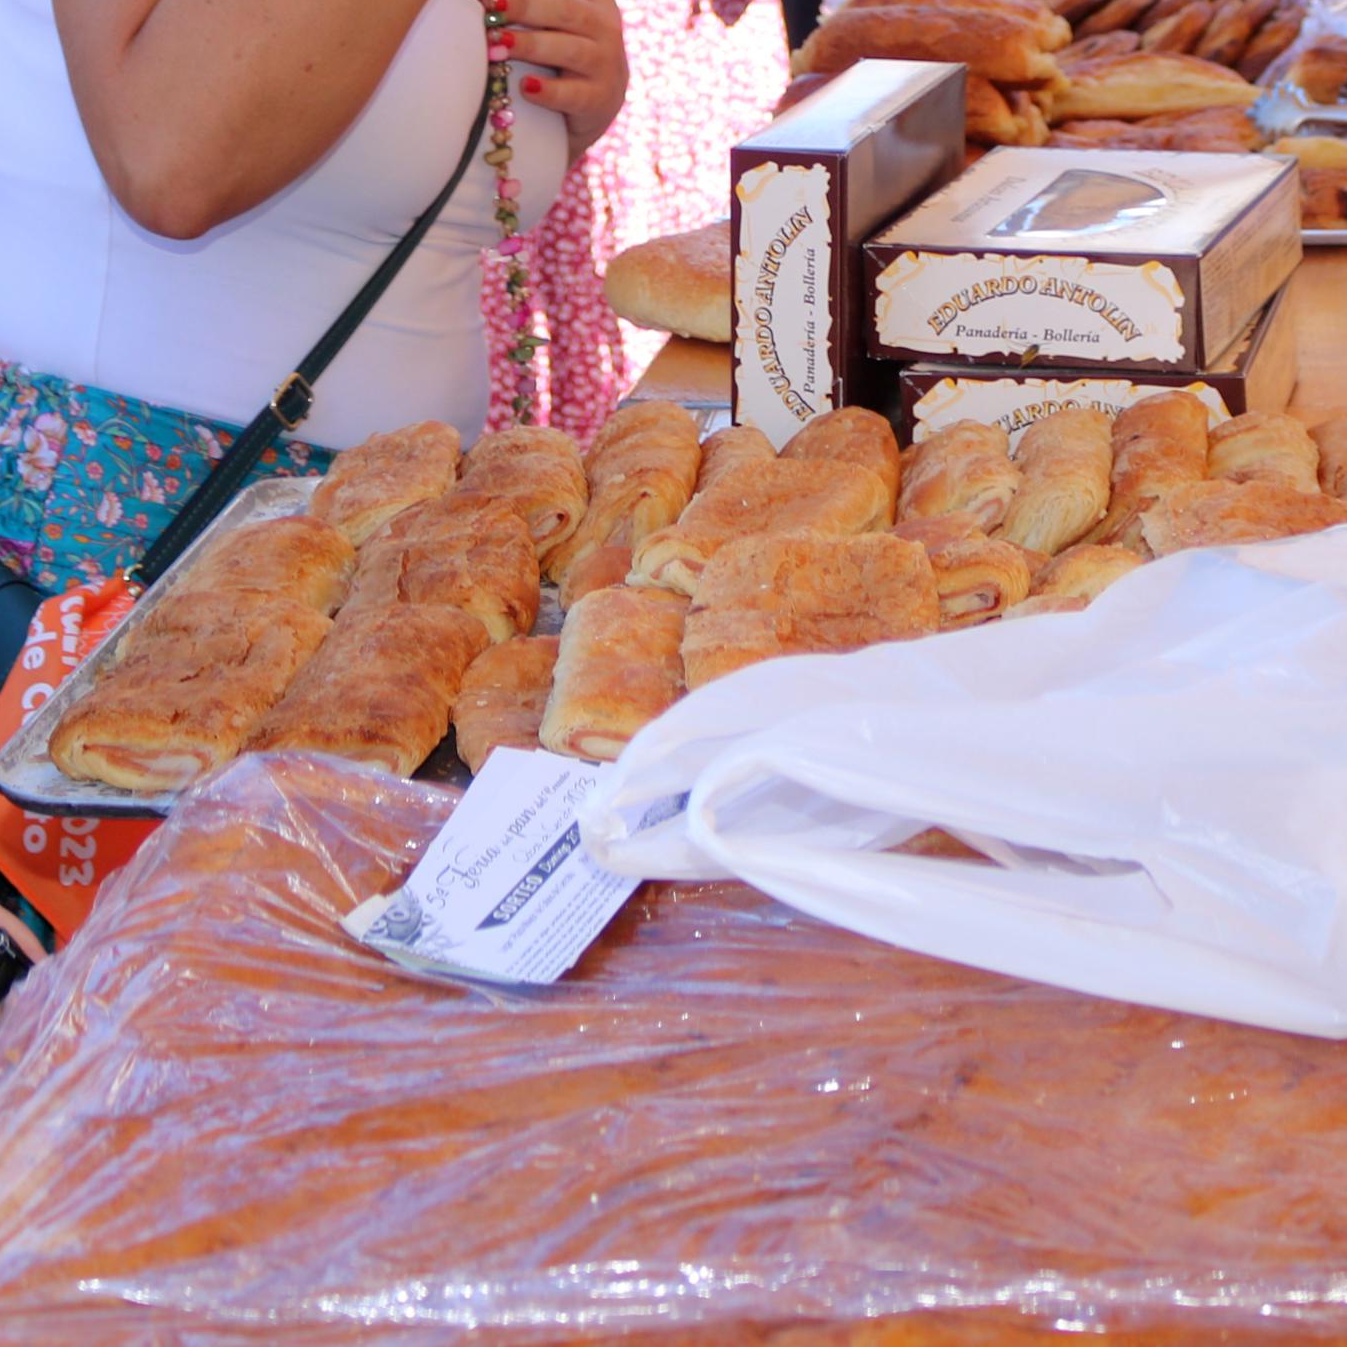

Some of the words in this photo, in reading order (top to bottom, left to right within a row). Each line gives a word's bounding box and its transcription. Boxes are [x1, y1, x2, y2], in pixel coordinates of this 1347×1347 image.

[755, 205, 813, 306] ANTOLIN
[803, 247, 818, 306] Bollería
[927, 275, 1037, 336] EDUARDO
[1039, 276, 1142, 342] ANTOLIN
[955, 324, 1028, 340] Panadería
[1043, 328, 1100, 344] Bollería
[754, 306, 816, 421] EDUARDO
[803, 319, 818, 394] Panadería
[508, 807, 537, 839] pan
[493, 874, 544, 921] SORTEO
